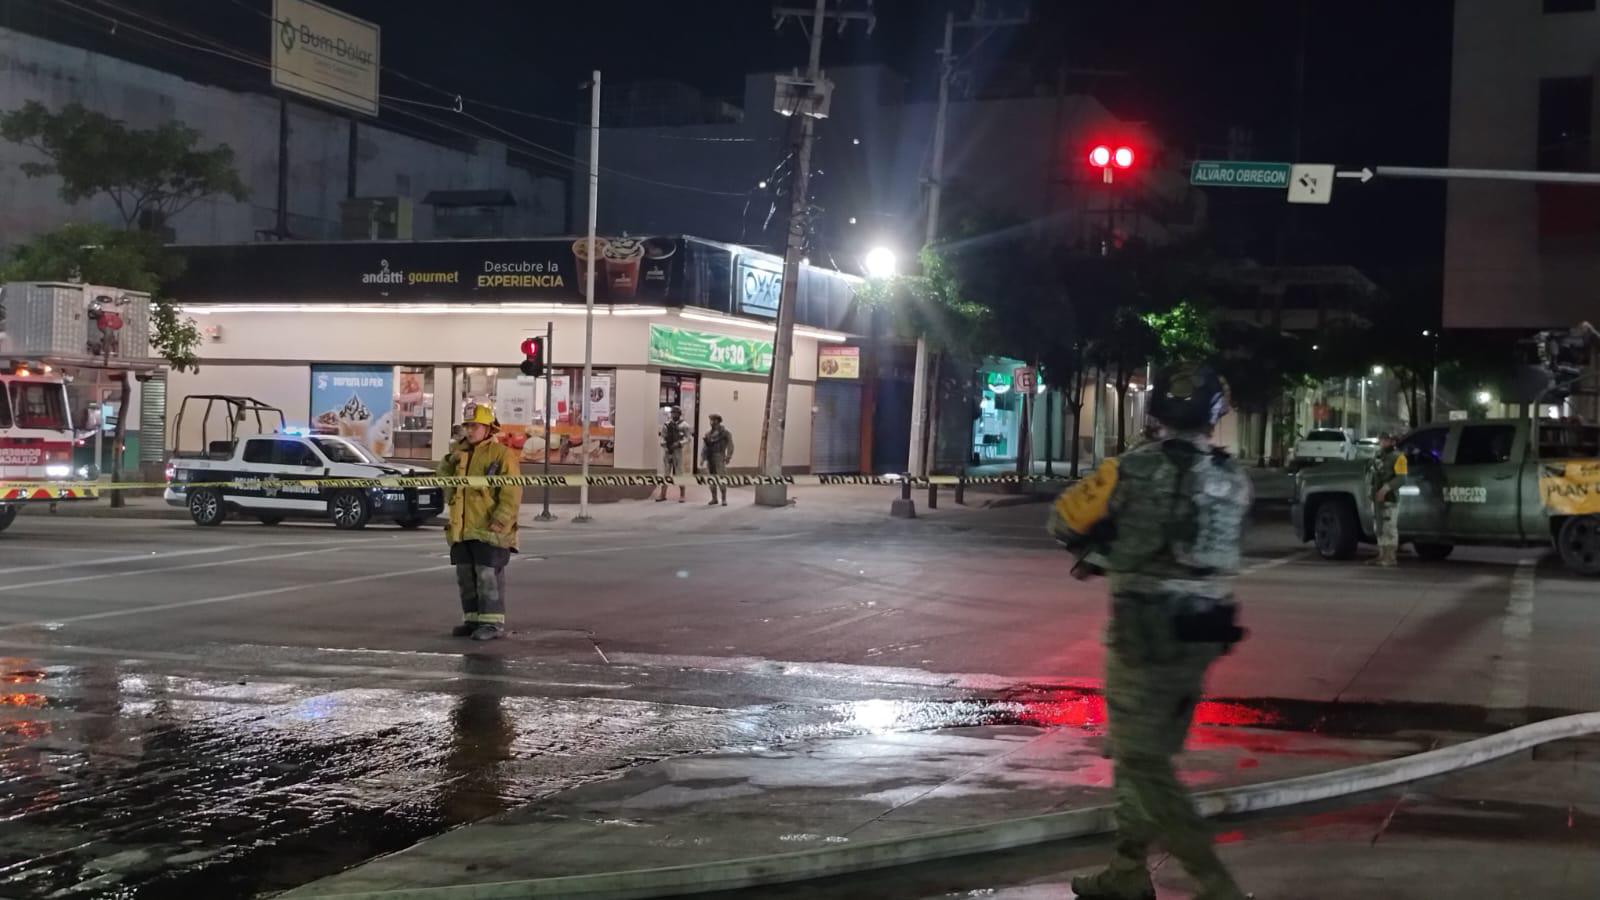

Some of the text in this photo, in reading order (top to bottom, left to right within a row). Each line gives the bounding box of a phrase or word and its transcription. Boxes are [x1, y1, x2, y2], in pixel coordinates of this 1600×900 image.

[1195, 168, 1287, 183] ALVARO OBREGON
[484, 260, 559, 273] Descubre la
[362, 270, 459, 285] andatti gourmet
[477, 275, 564, 288] EXPERIENCIA
[1547, 483, 1589, 498] PLAN
